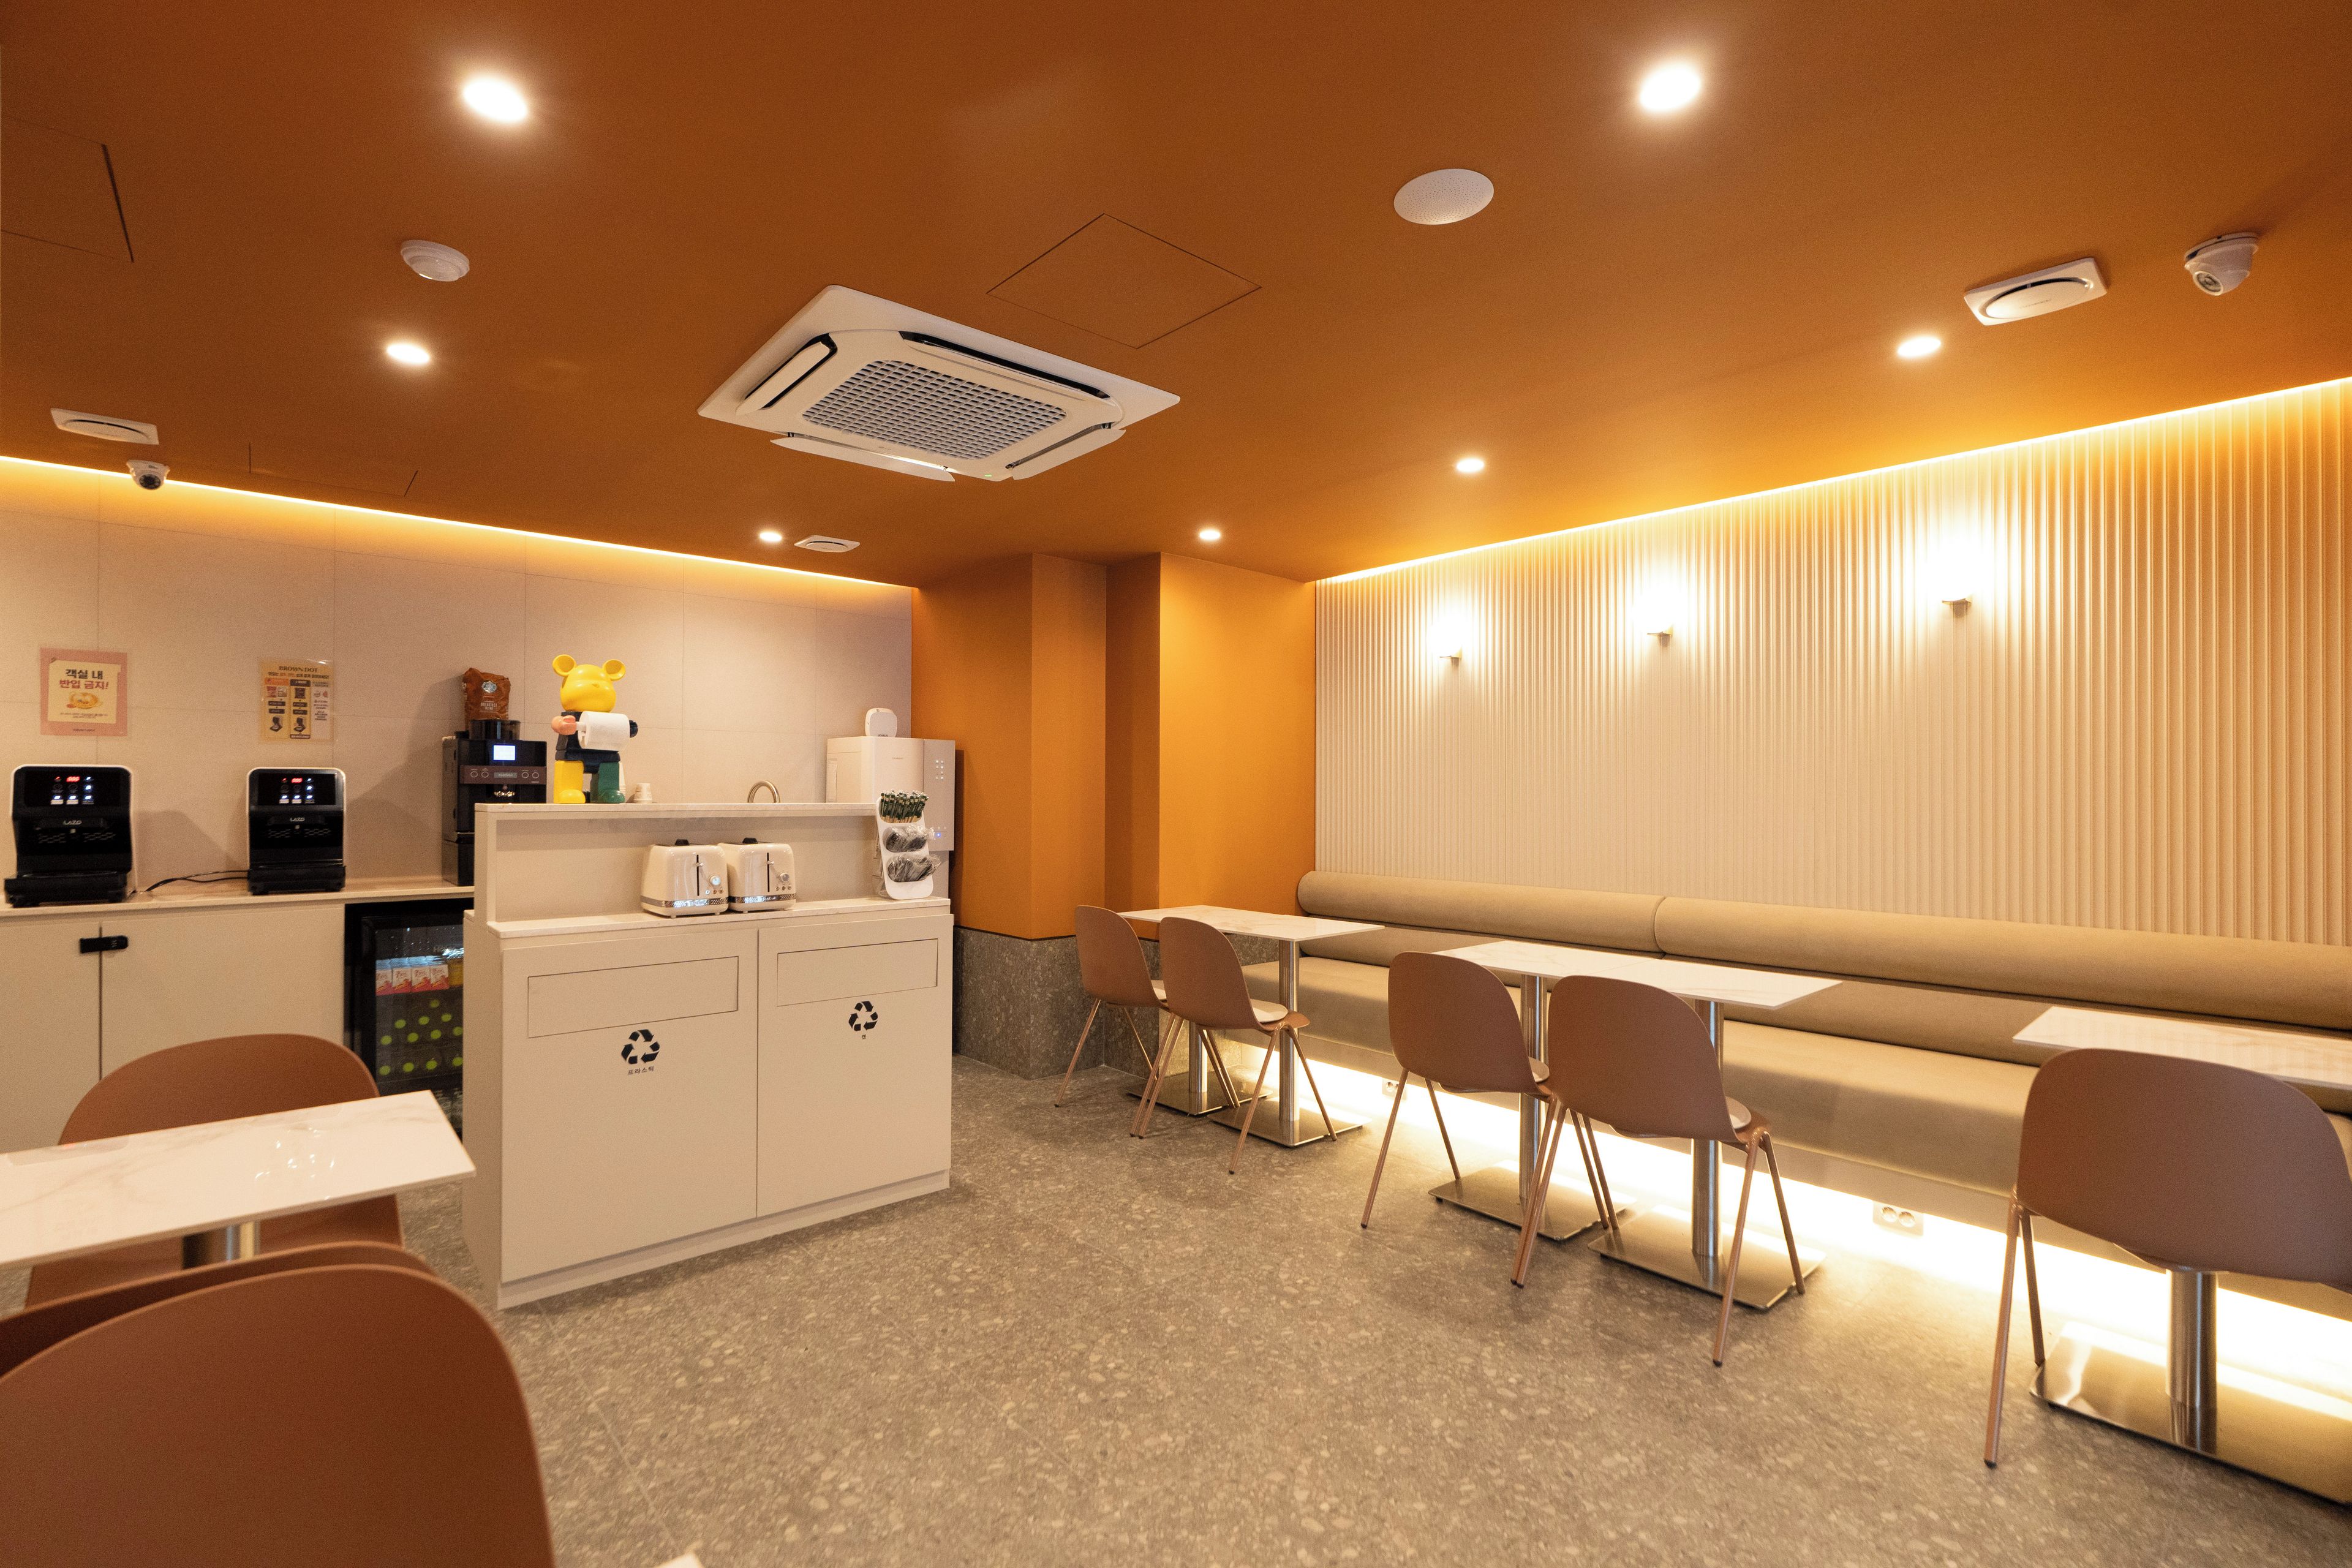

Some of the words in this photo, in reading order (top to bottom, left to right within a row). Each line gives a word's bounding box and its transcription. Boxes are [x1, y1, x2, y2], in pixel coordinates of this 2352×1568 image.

[66, 669, 88, 679] 객실
[92, 670, 103, 679] 내
[59, 679, 80, 689] 반입
[84, 680, 108, 690] 금지!
